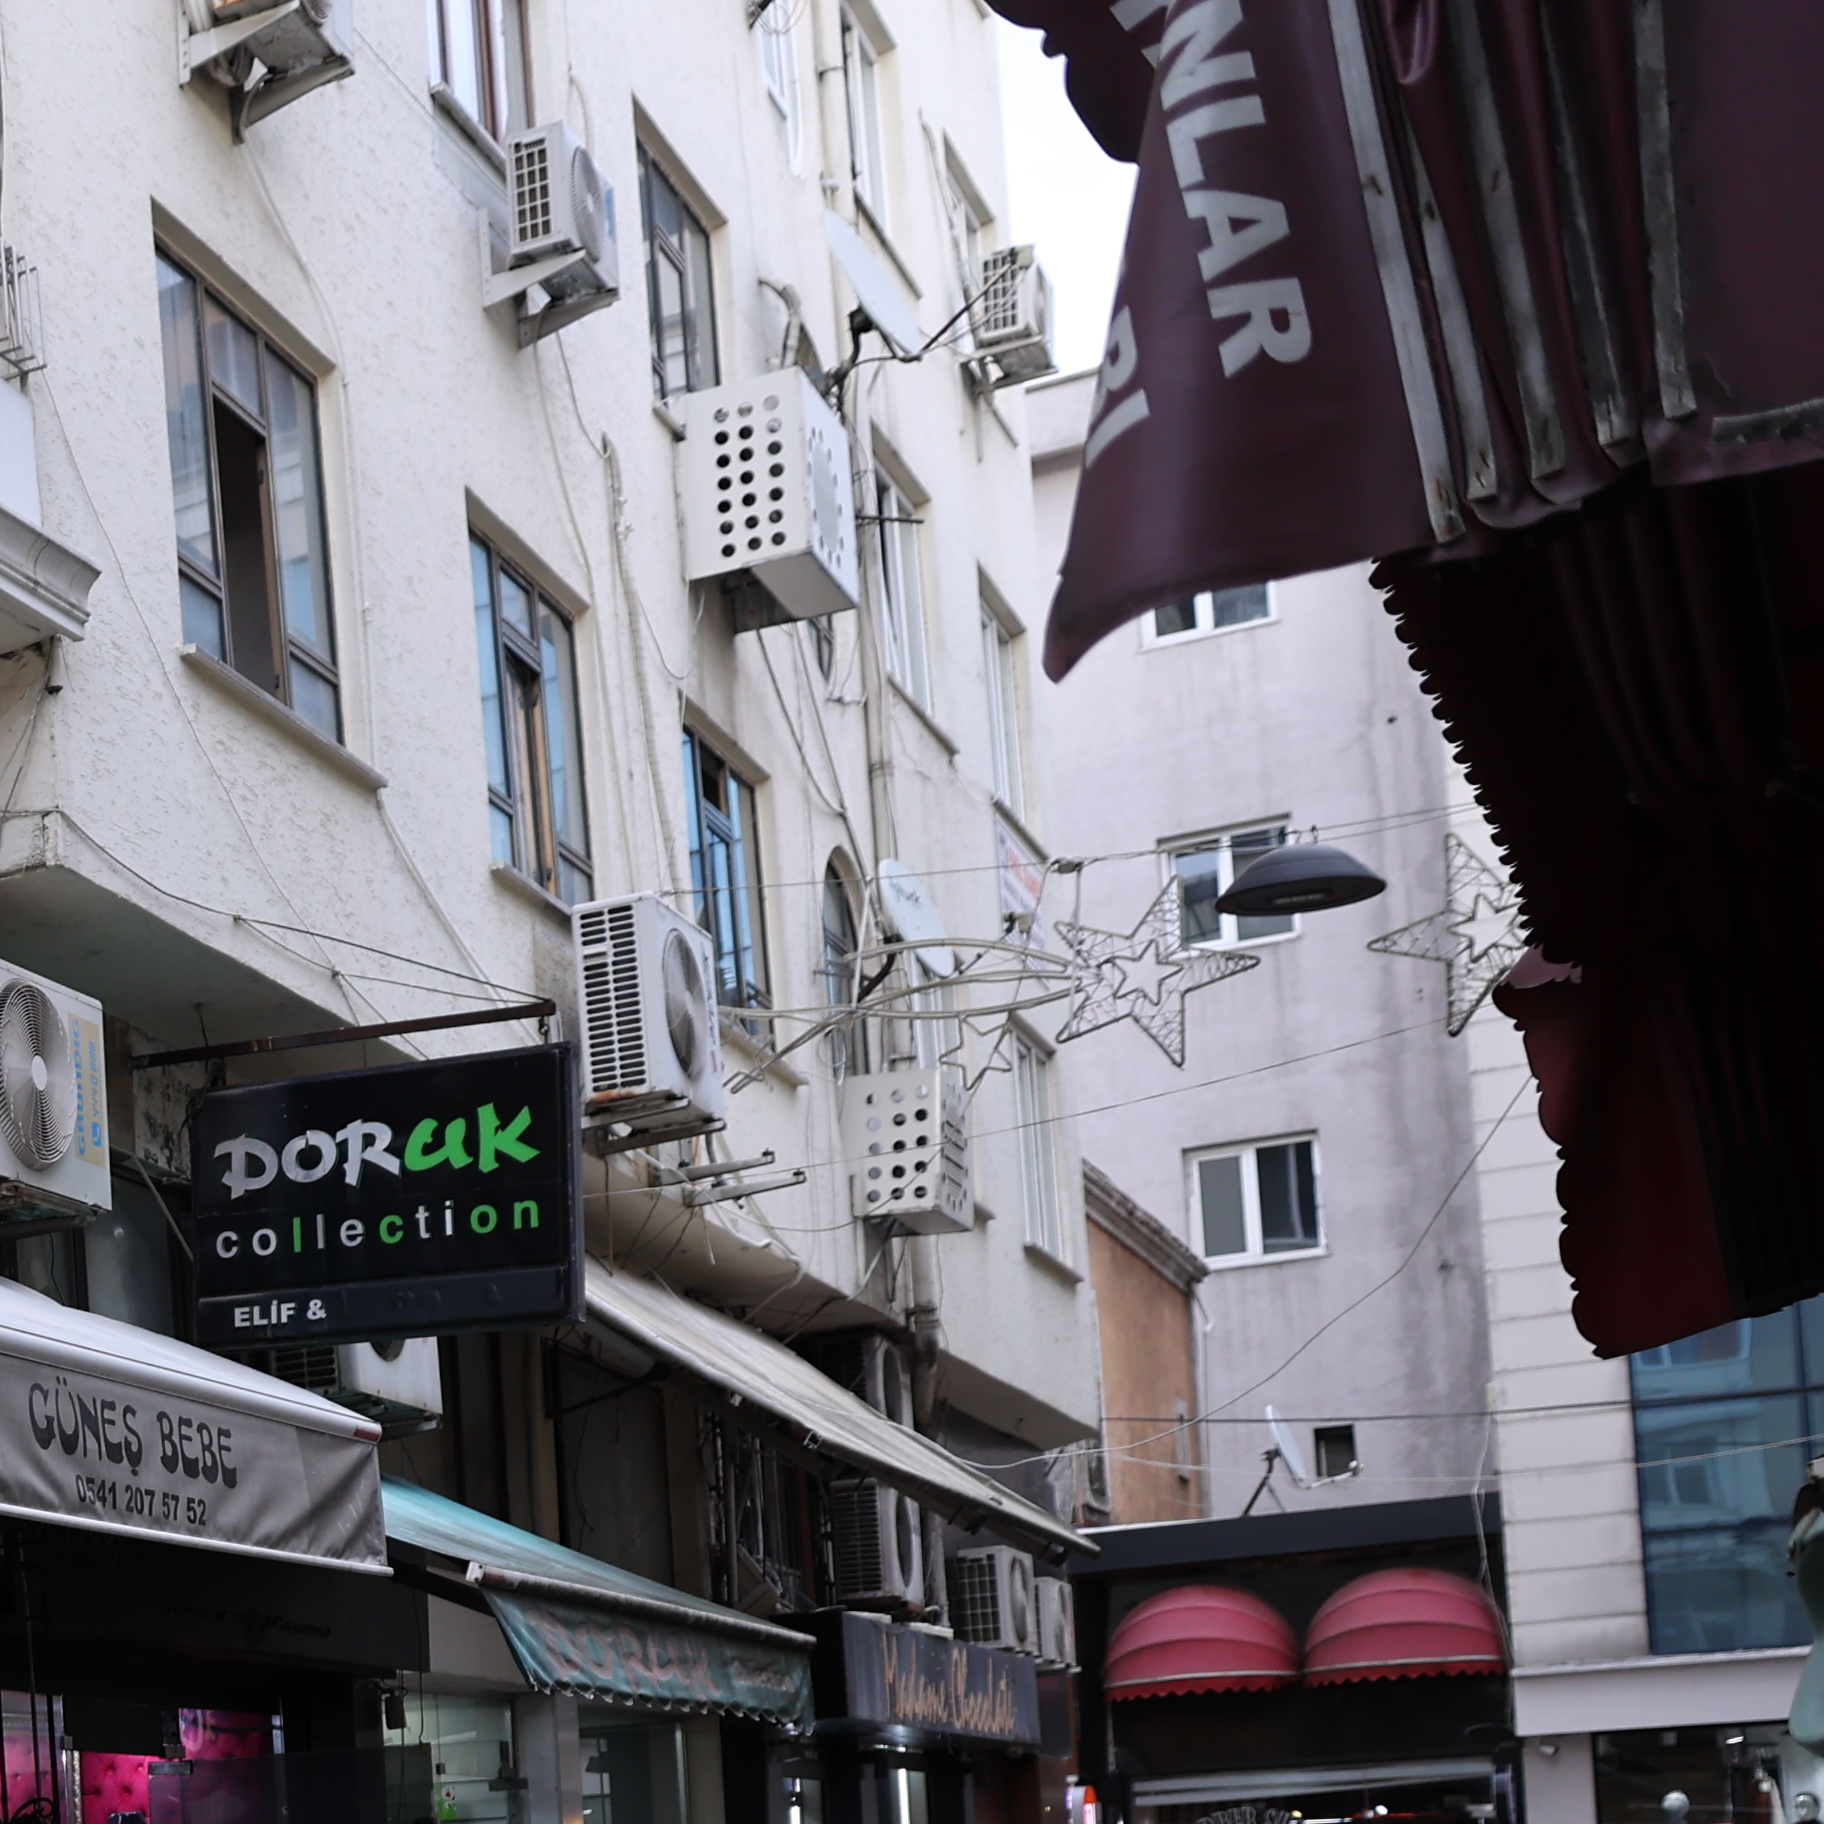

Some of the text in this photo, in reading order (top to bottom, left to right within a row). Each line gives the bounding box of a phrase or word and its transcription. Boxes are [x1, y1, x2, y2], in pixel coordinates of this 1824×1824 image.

[215, 1200, 540, 1259] collection
[234, 1299, 327, 1328] ELİF &
[28, 1375, 238, 1488] GÜNEŞ BEBE
[75, 1474, 207, 1527] 0541 207 57 52
